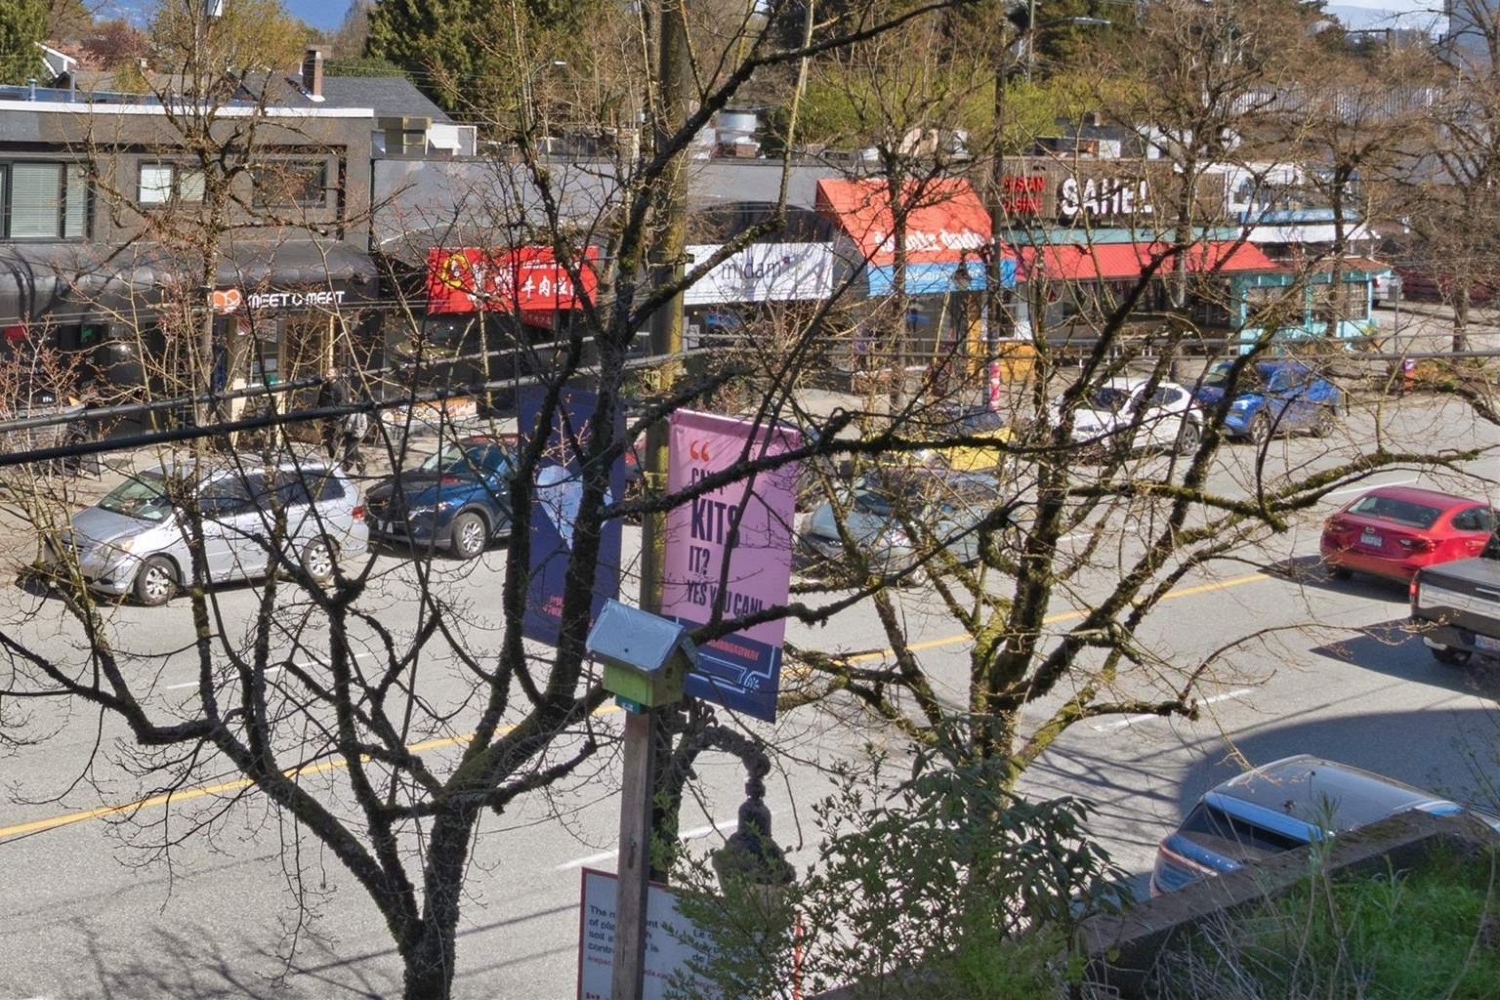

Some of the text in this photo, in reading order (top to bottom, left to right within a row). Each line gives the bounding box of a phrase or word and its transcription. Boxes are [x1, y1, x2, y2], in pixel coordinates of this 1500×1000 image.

[248, 293, 290, 309] MEET
[689, 545, 711, 576] IT?
[687, 580, 708, 607] YES
[710, 584, 732, 613] YU
